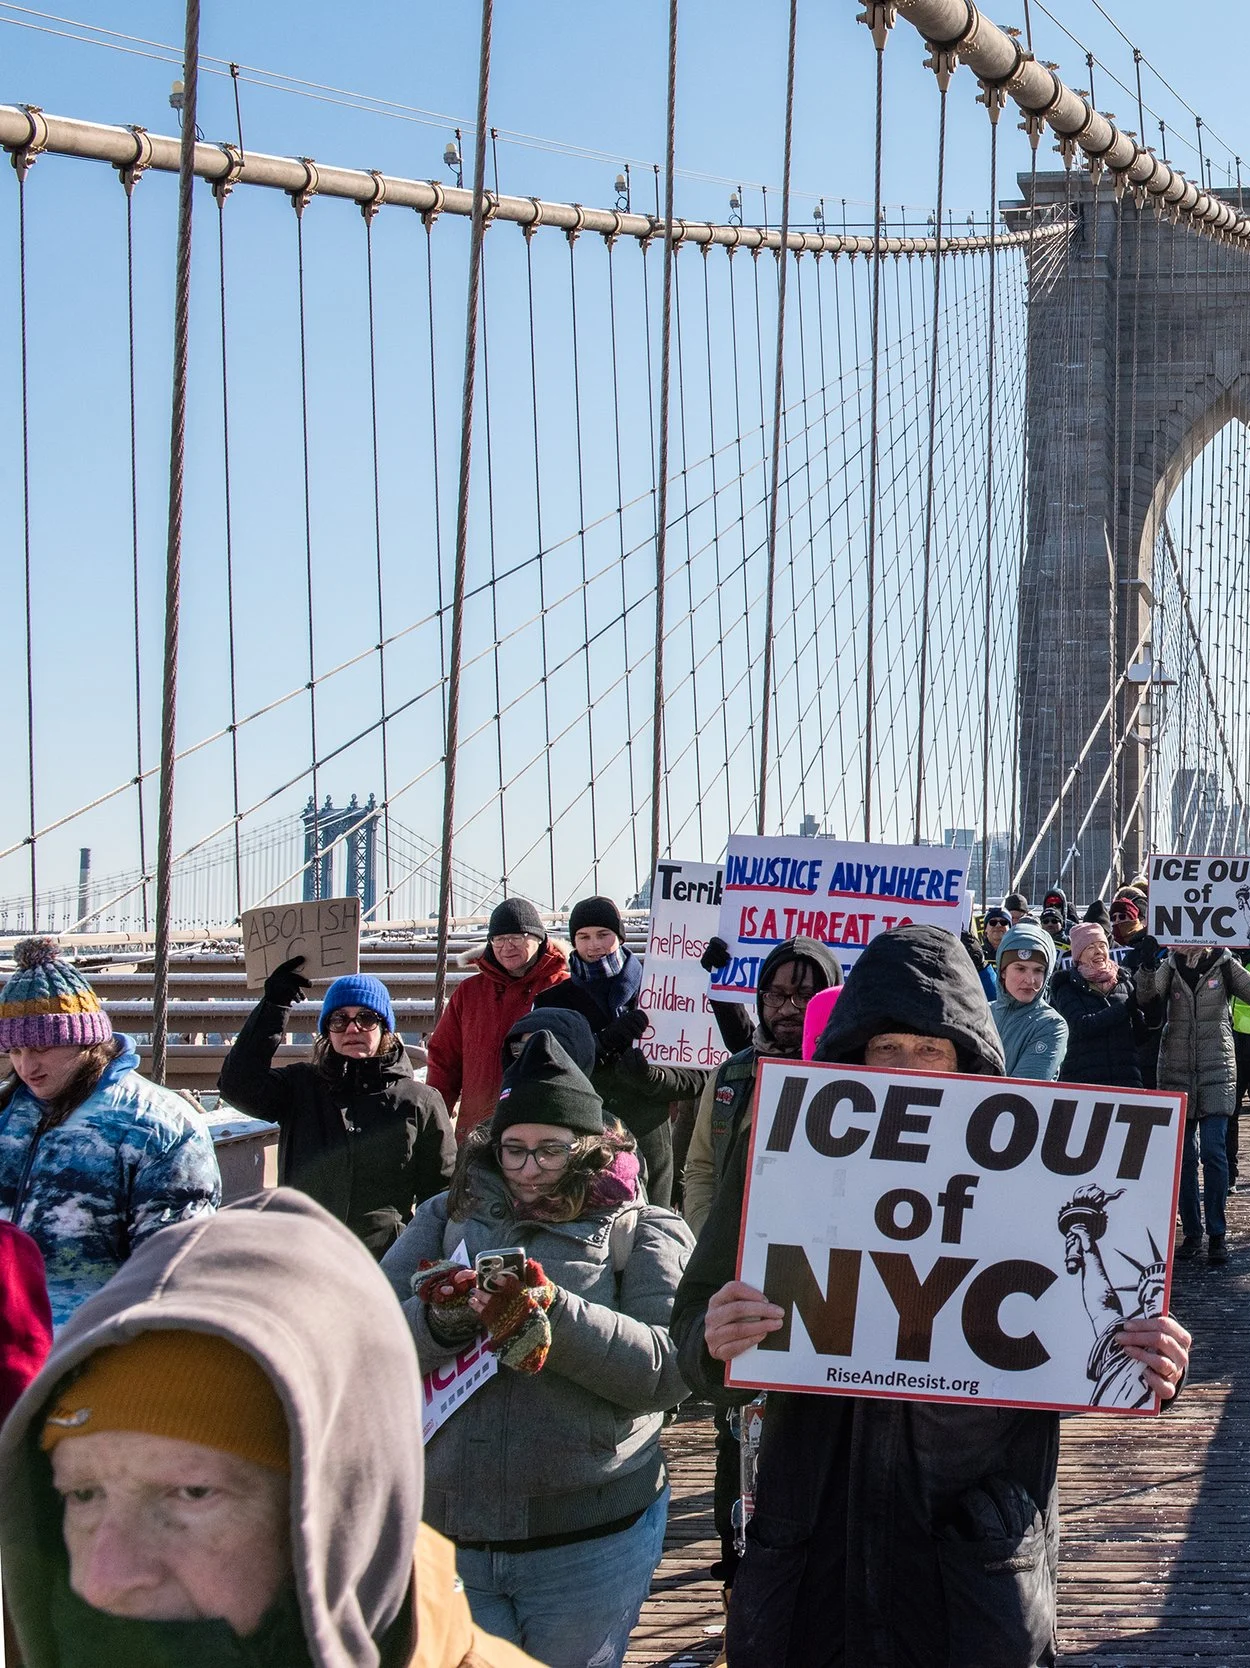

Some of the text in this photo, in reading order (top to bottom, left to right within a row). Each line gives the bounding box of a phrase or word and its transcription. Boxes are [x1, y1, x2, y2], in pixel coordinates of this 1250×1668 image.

[726, 855, 962, 901] INJUSTICE ANYWHERE
[1153, 859, 1200, 881] ICE
[1184, 884, 1212, 903] of
[248, 904, 357, 949] ABOLISH
[739, 906, 758, 937] IS
[760, 908, 778, 939] A
[784, 908, 875, 945] THREAT
[1154, 905, 1237, 938] NYC
[251, 931, 348, 981] ICE
[640, 973, 695, 1012] children
[638, 1025, 693, 1062] Parents
[765, 1076, 1173, 1180] ICE OUT
[874, 1174, 980, 1244] of
[757, 1243, 1058, 1371] NYC
[827, 1367, 979, 1395] RiseAndResist.org
